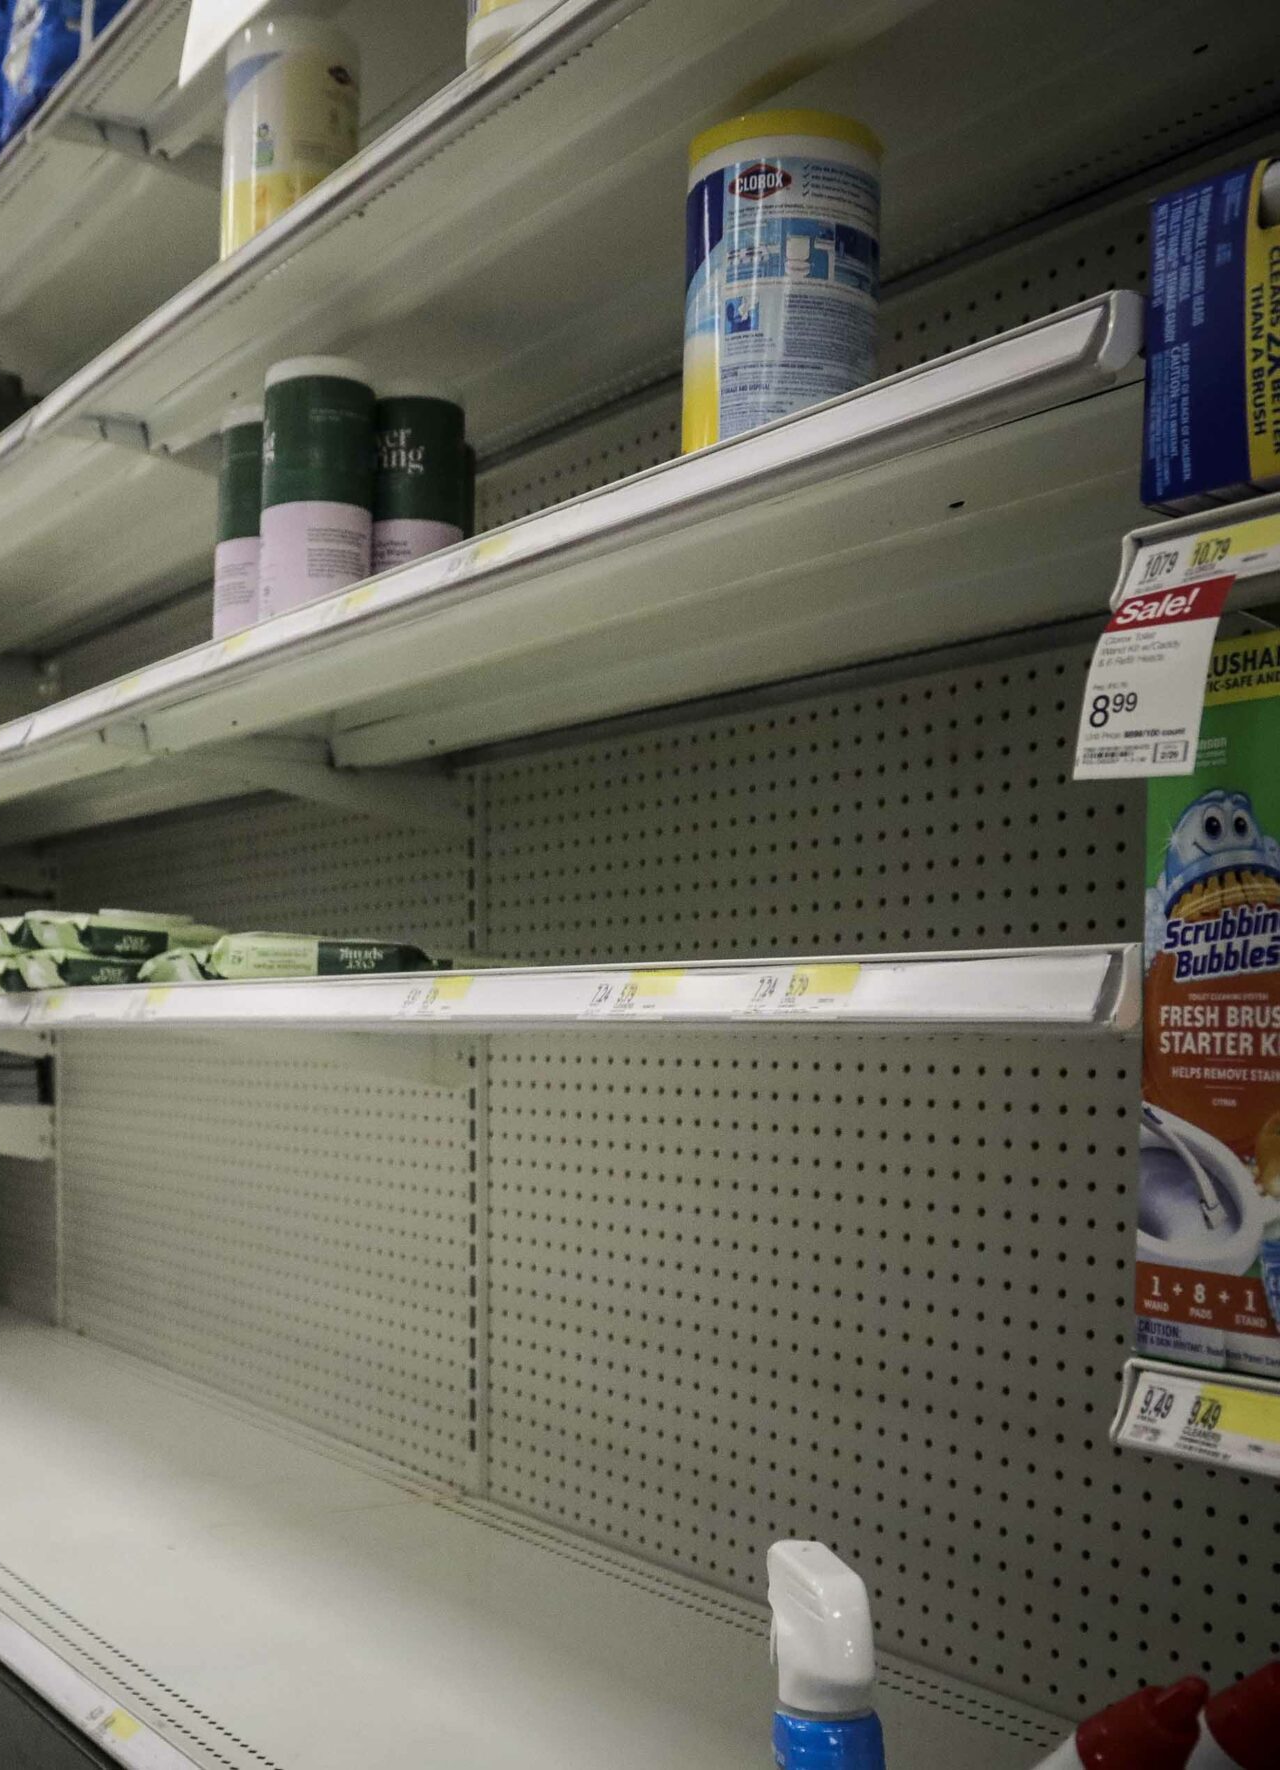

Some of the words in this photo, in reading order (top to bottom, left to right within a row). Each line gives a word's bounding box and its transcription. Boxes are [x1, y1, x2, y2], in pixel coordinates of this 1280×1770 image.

[736, 173, 784, 193] CLOROX
[1251, 283, 1265, 340] THAN
[1252, 347, 1265, 362] A
[1253, 367, 1267, 436] BRUSH
[1116, 588, 1201, 625] Sale!
[1207, 645, 1280, 678] USHA
[1165, 905, 1280, 949] Scrubbin
[1175, 940, 1280, 979] Bubbles
[1160, 1005, 1220, 1028] FRESH
[1227, 1005, 1280, 1028] BRUS
[1160, 1031, 1254, 1056] STARTER
[1261, 1032, 1280, 1056] K
[1171, 1066, 1202, 1079] HELPS
[1204, 1067, 1248, 1080] REMOVE
[1143, 1299, 1170, 1313] WAND
[1193, 1283, 1206, 1304] 8
[1140, 1388, 1175, 1419] 9.49
[1187, 1398, 1222, 1431] 9.49
